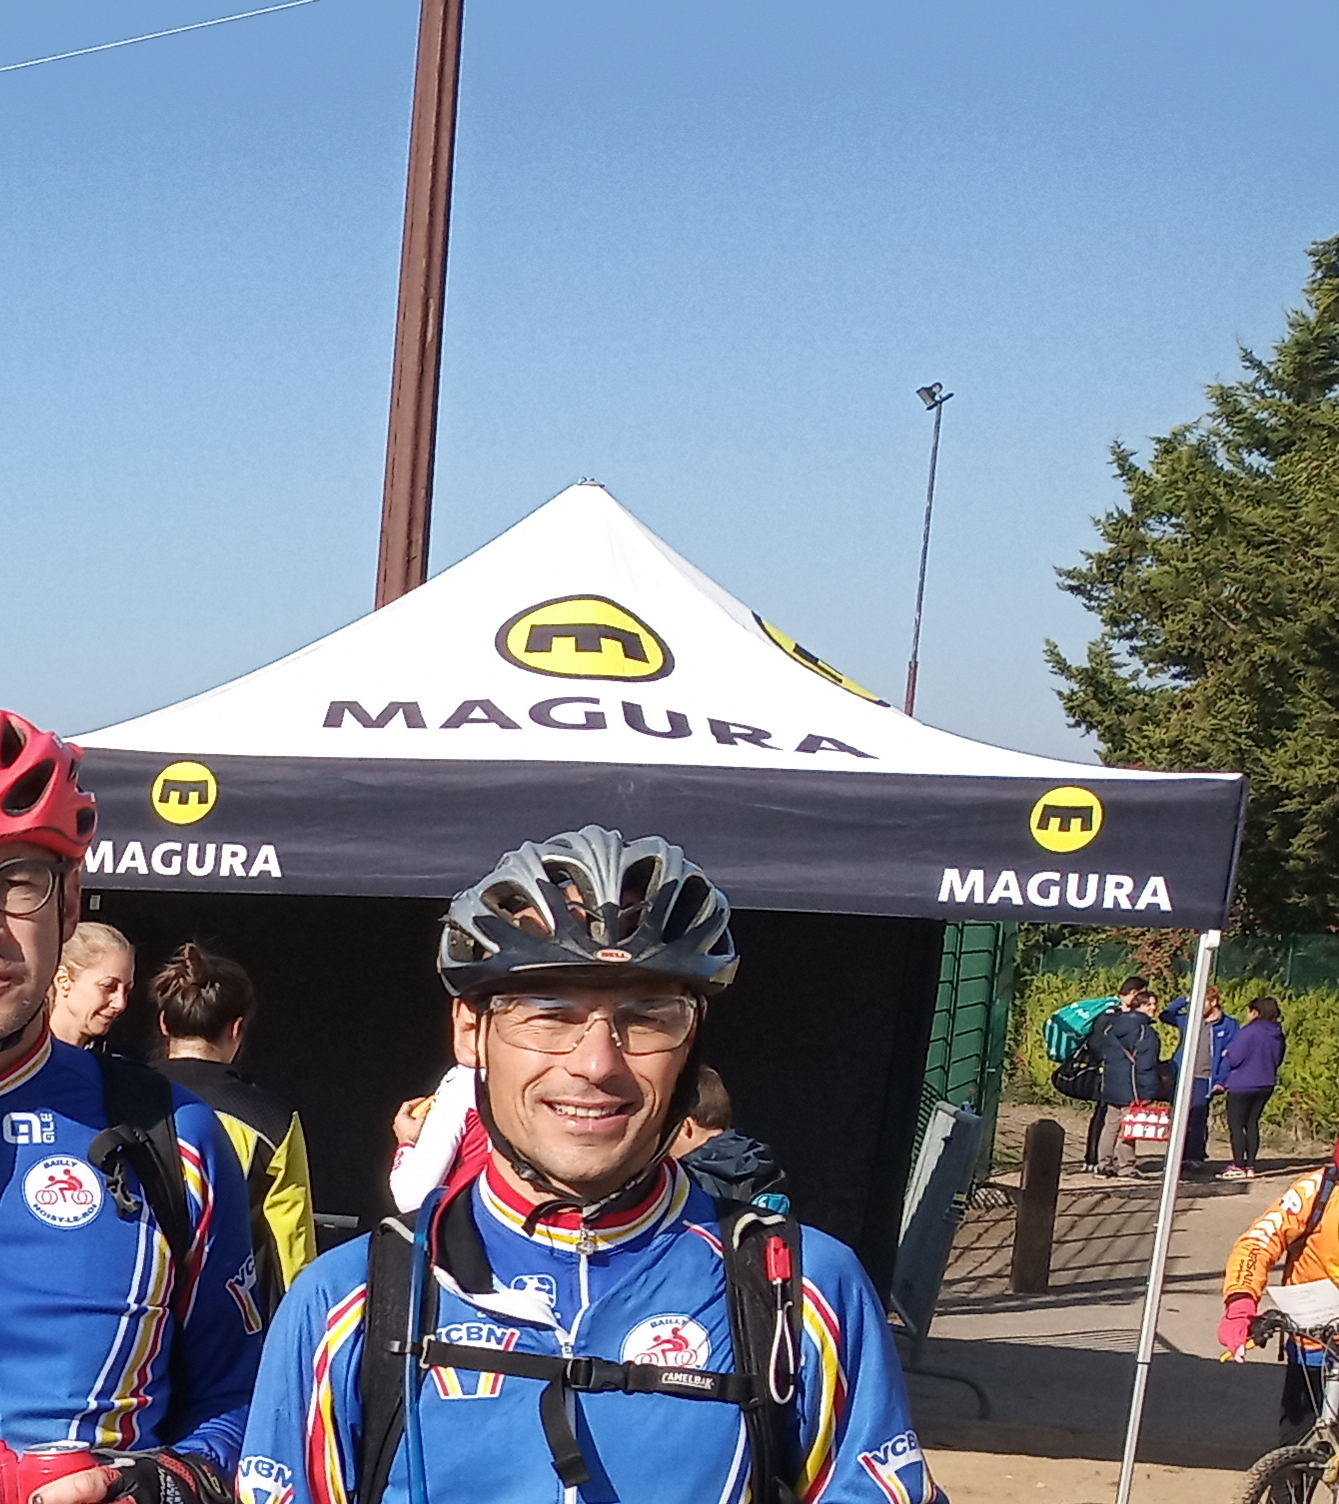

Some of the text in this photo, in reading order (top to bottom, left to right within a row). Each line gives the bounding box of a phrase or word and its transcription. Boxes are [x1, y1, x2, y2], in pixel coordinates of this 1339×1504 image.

[323, 696, 879, 760] MAGURA
[85, 839, 283, 878] MAGURA
[937, 868, 1173, 912] MAGURA
[43, 1159, 78, 1169] BAILLY
[870, 1432, 918, 1466] VCB
